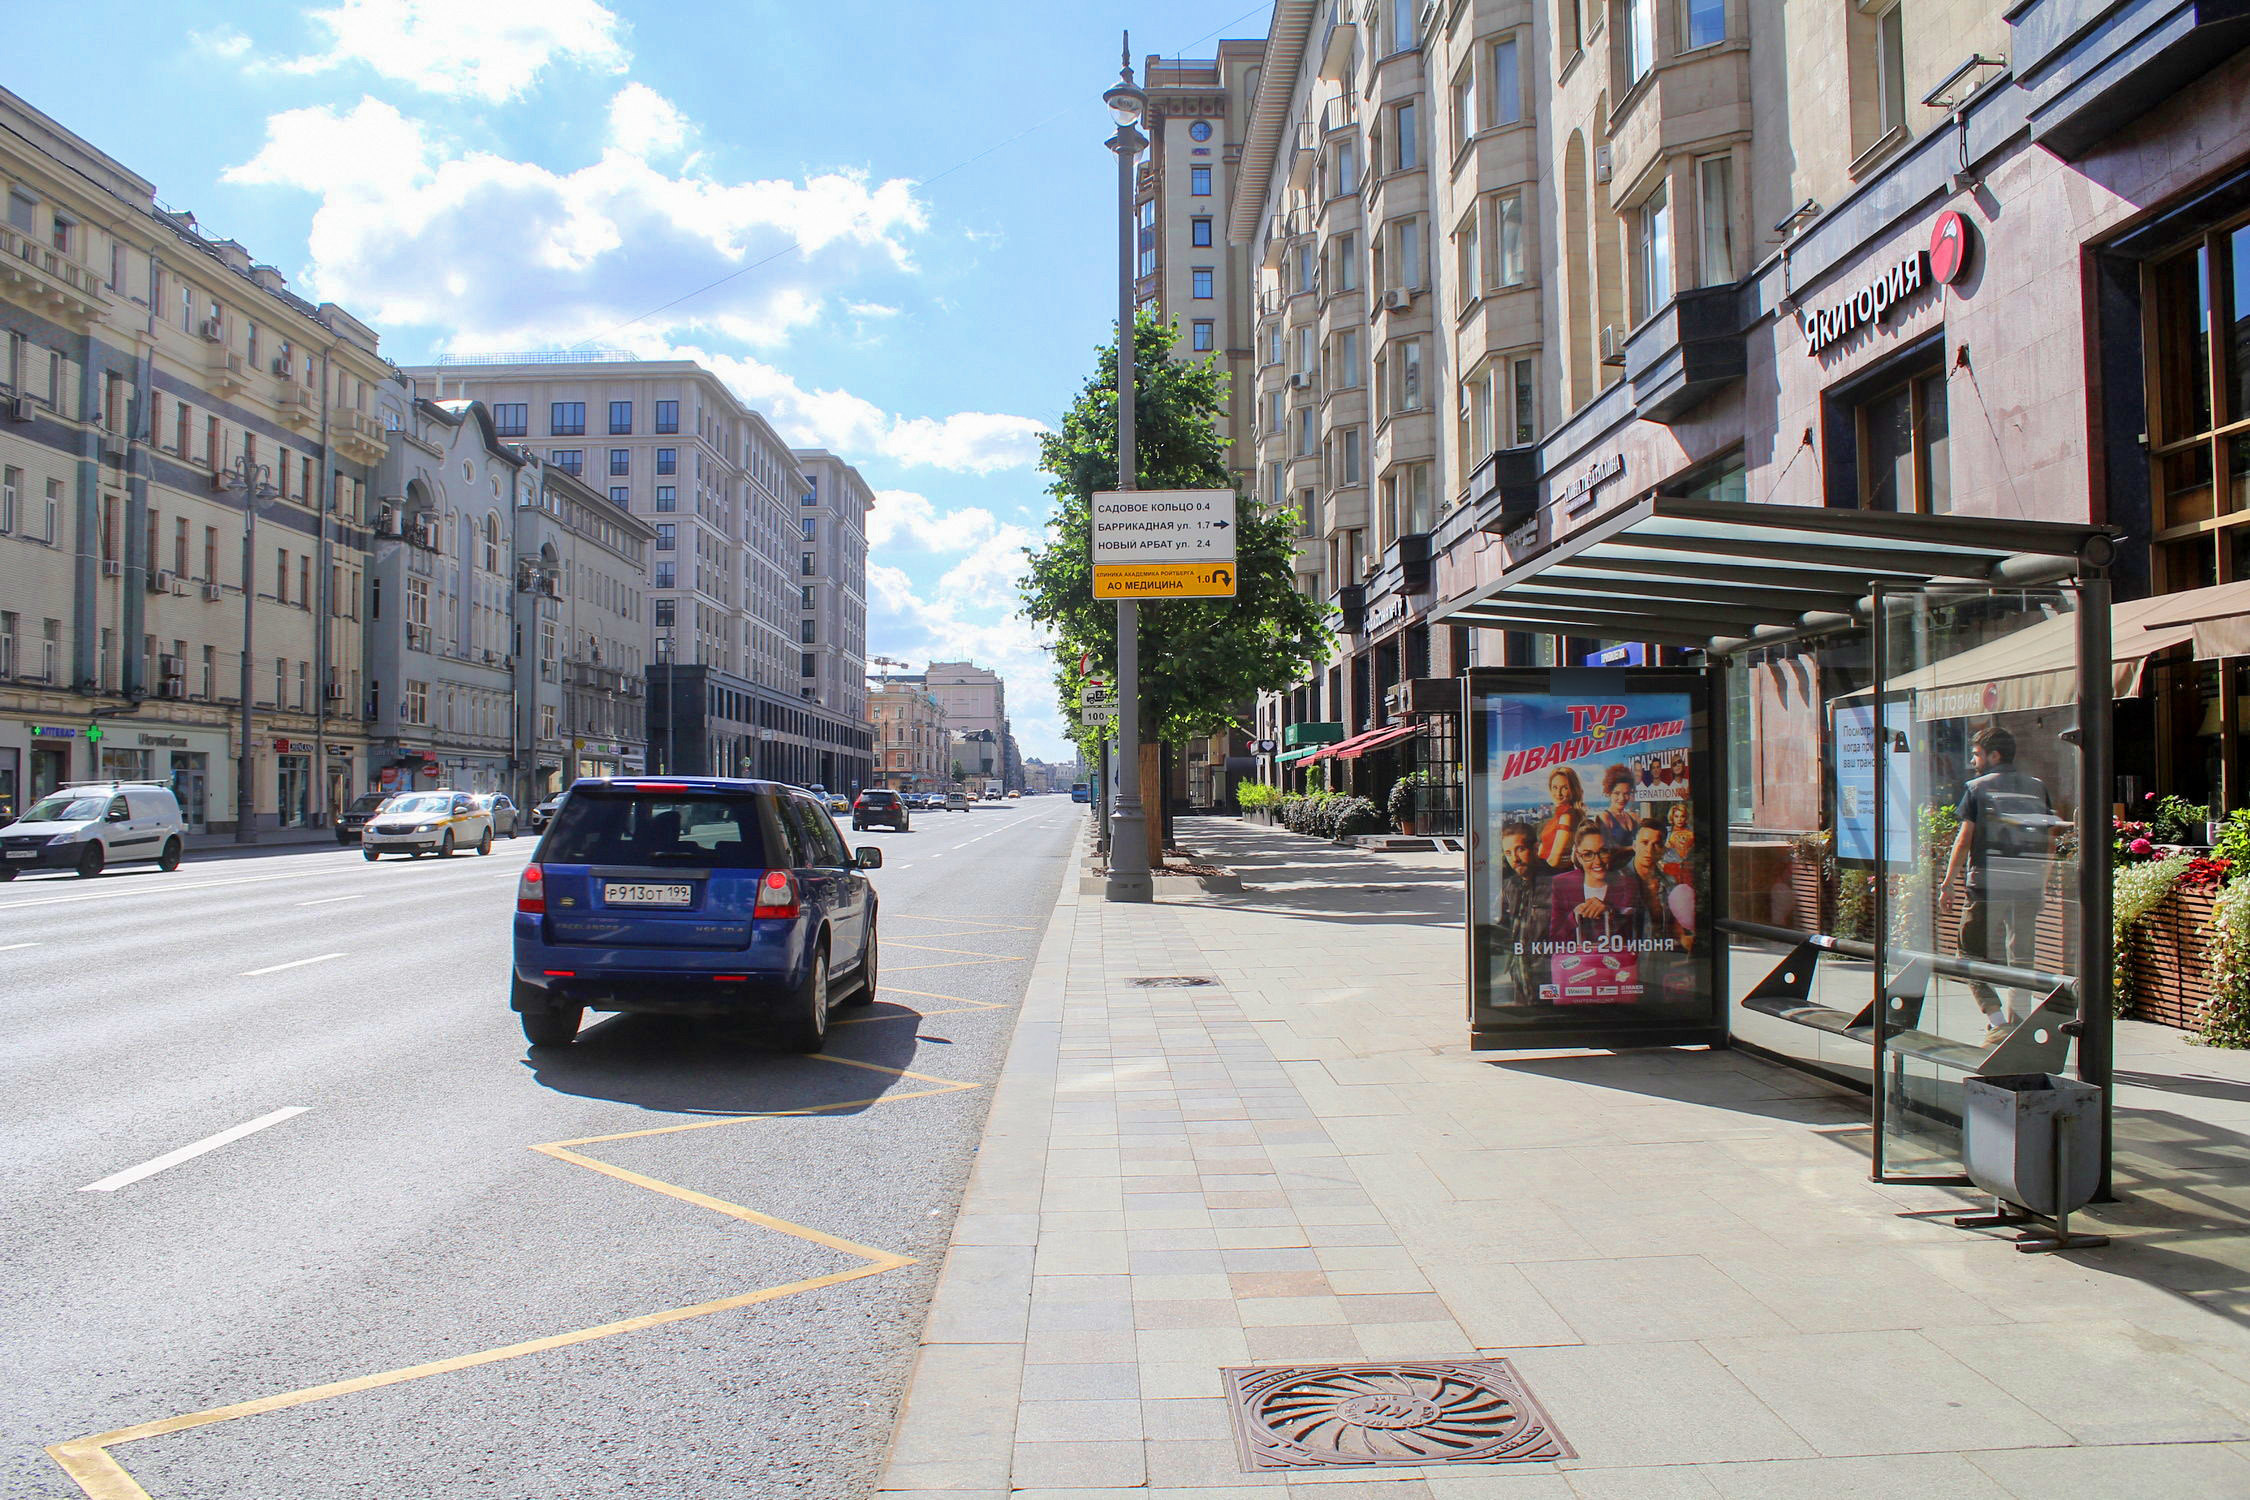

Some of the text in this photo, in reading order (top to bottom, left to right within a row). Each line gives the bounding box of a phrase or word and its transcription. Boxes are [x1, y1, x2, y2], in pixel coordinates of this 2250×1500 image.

[1804, 250, 1922, 353] Якитория
[1098, 502, 1211, 514] САДОВОЕ КОЛЬЦО 0.4
[1098, 521, 1211, 533] БАРРИКАДНАЯ ул. 1.7
[1098, 539, 1211, 550] НОВЫЙ АРБАТ ул. 2.4
[1107, 580, 1184, 591] АО МЕДИЦИНА
[1197, 575, 1211, 584] 1.0
[1087, 712, 1105, 721] 100
[1566, 704, 1628, 734] ТУР
[1843, 725, 1875, 739] Посмотри
[1501, 719, 1685, 782] ИВАНУШКАМИ
[1634, 788, 1684, 799] TERNATION
[609, 886, 687, 901] Р913ОТ 199
[1513, 934, 1675, 956] В КИНО С 20 ИЮНЯ
